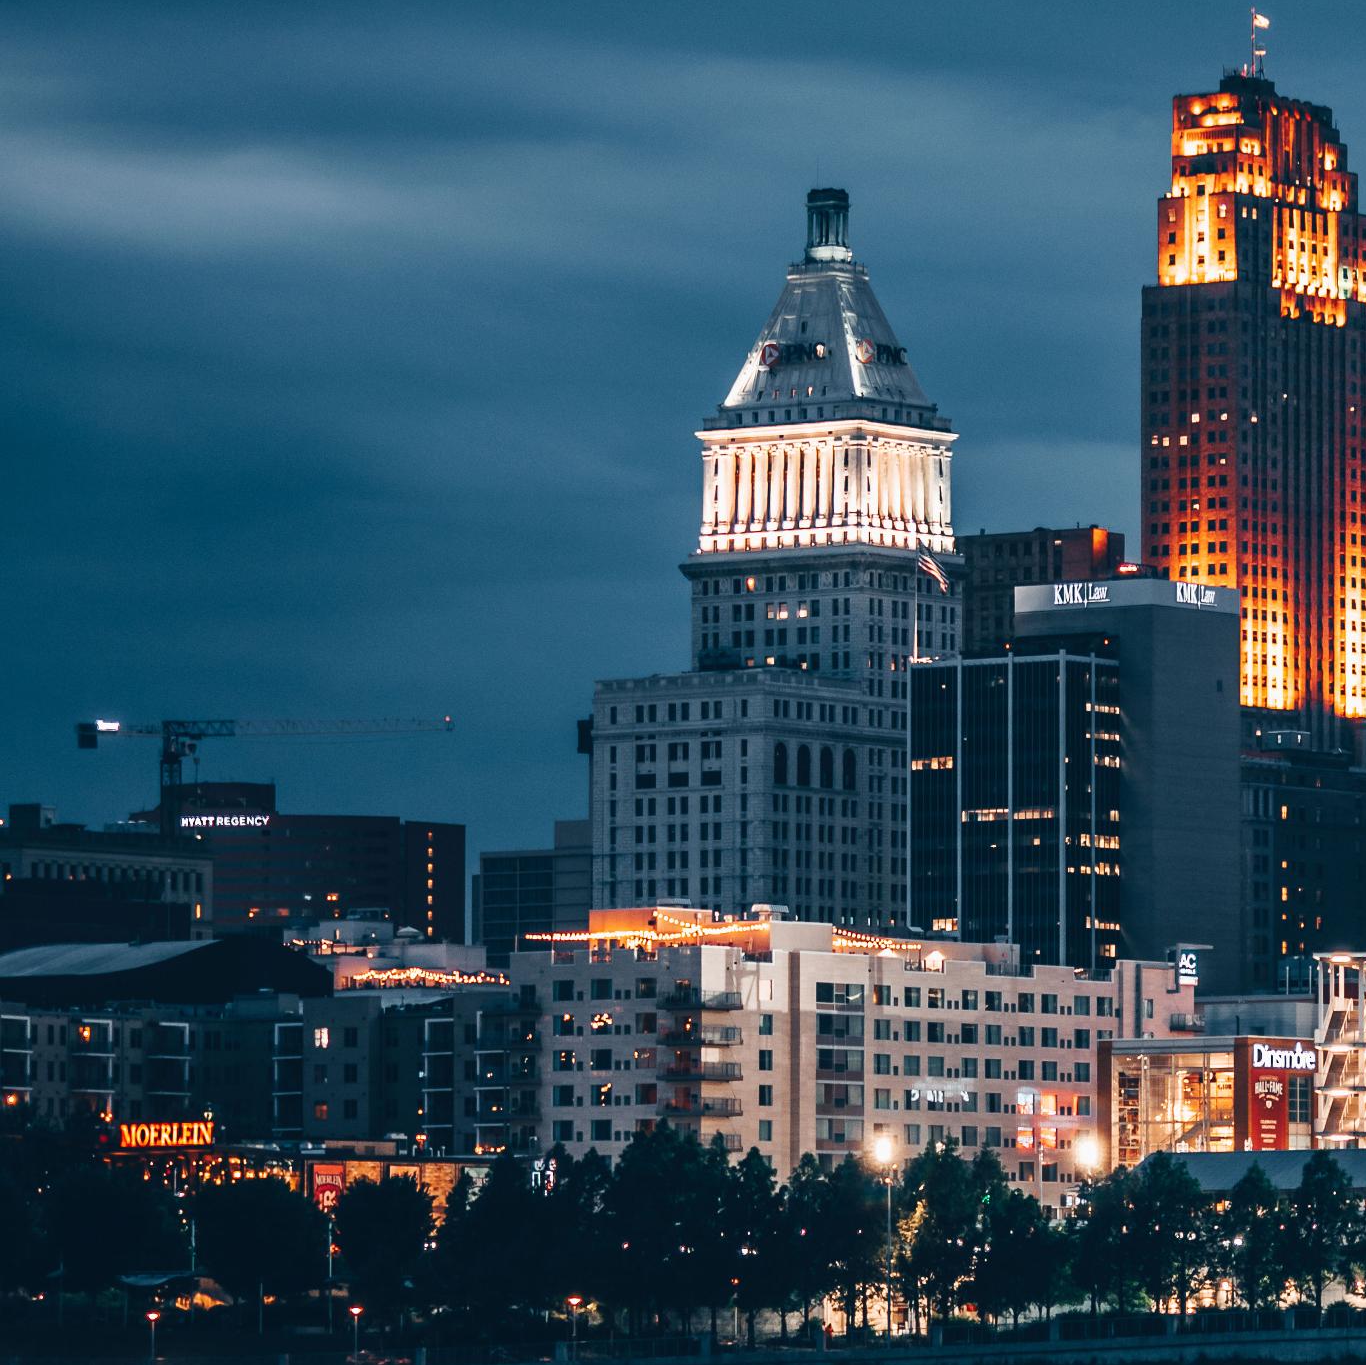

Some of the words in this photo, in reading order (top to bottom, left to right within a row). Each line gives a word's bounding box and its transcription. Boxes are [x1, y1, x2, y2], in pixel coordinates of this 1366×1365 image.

[1054, 583, 1083, 605] KMK
[1088, 584, 1108, 601] Law
[1176, 582, 1198, 604] KMK
[1201, 586, 1216, 603] Law
[181, 816, 215, 827] HYATT
[216, 816, 270, 826] REGENCY
[1179, 953, 1197, 969] AC
[1253, 1042, 1316, 1070] Dinsmore
[1255, 1081, 1268, 1095] HALL
[1269, 1081, 1283, 1095] FAME
[120, 1122, 214, 1147] MOERLEIN
